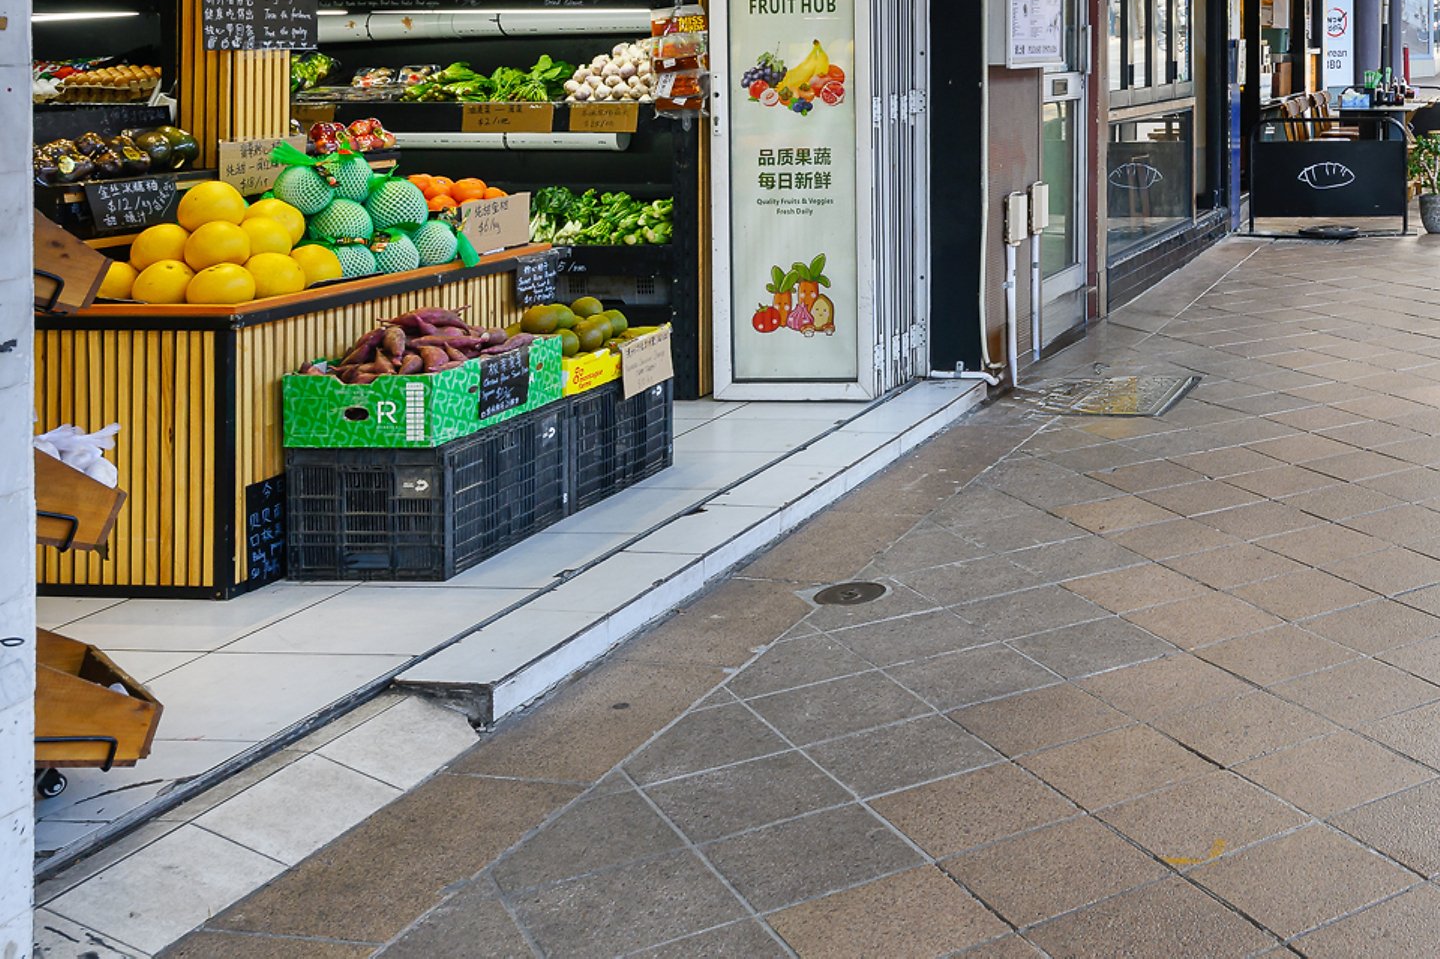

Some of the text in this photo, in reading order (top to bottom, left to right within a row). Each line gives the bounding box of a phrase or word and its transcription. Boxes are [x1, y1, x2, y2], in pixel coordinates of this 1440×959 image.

[758, 147, 832, 166] 品质果蔬
[758, 171, 832, 190] 每日新鲜
[756, 198, 780, 206] Quality
[808, 197, 834, 206] Veggies
[776, 207, 813, 217] Fresh Daily
[376, 401, 397, 424] R
